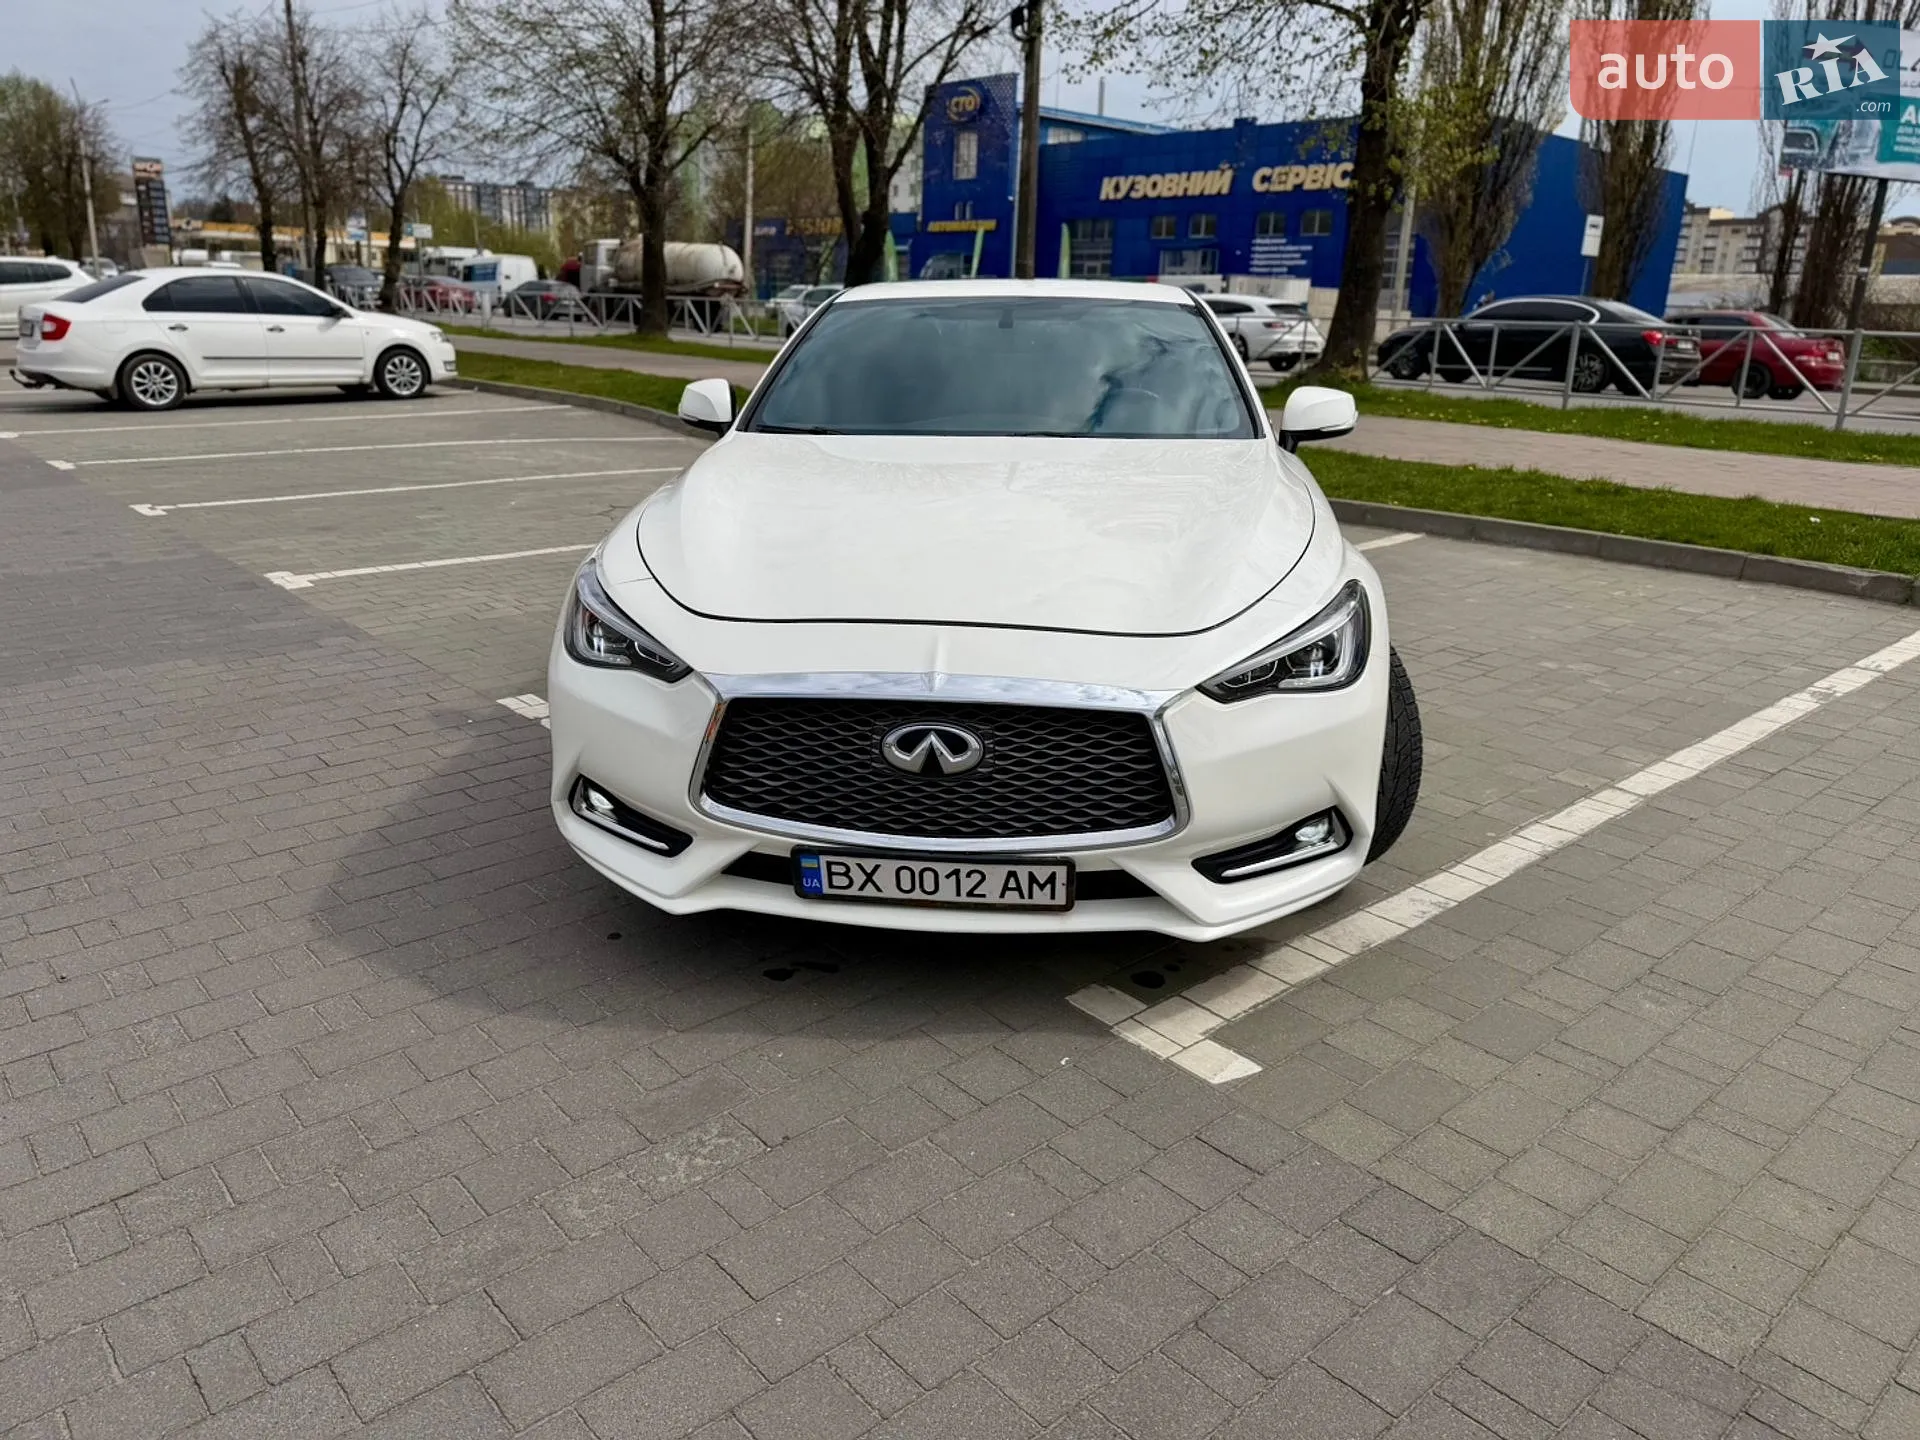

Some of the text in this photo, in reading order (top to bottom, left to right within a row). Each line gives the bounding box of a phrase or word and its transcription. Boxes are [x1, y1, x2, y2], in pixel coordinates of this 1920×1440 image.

[1099, 161, 1354, 200] КУЗОВНИЙ СЕРВІС
[802, 878, 821, 889] UA
[825, 861, 1057, 900] BX 0012 AM
